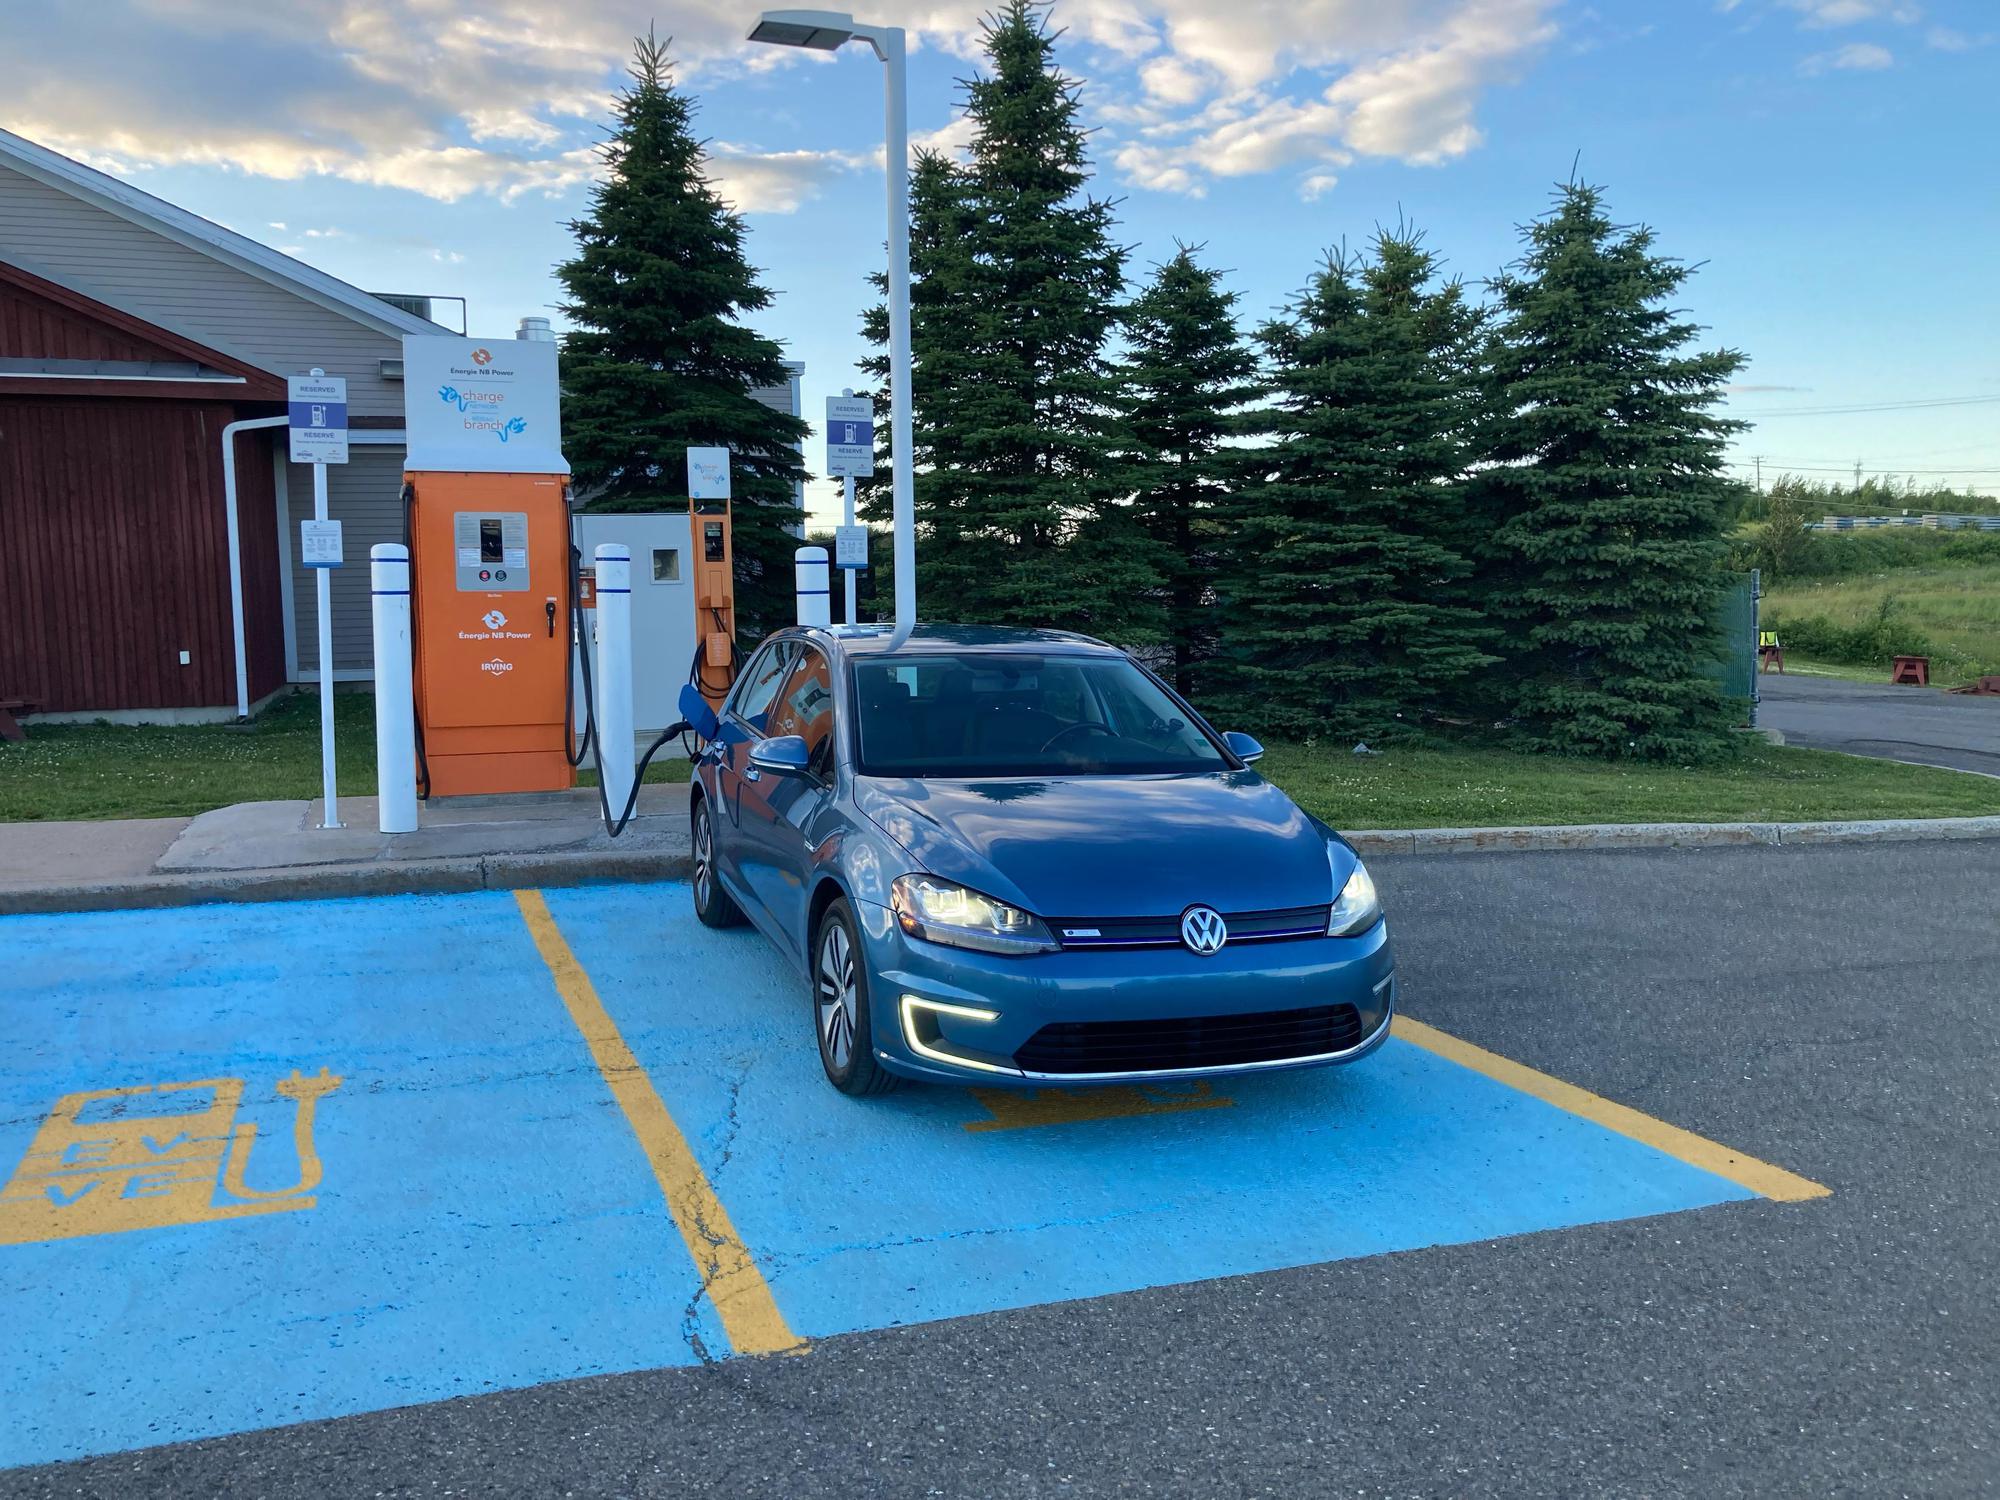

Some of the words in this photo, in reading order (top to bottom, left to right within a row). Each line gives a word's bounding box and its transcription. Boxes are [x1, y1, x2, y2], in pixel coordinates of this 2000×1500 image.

[463, 389, 504, 404] charge
[464, 417, 504, 430] branch
[458, 631, 490, 640] Énergie
[481, 663, 513, 671] IRVING
[1182, 908, 1227, 954] VW
